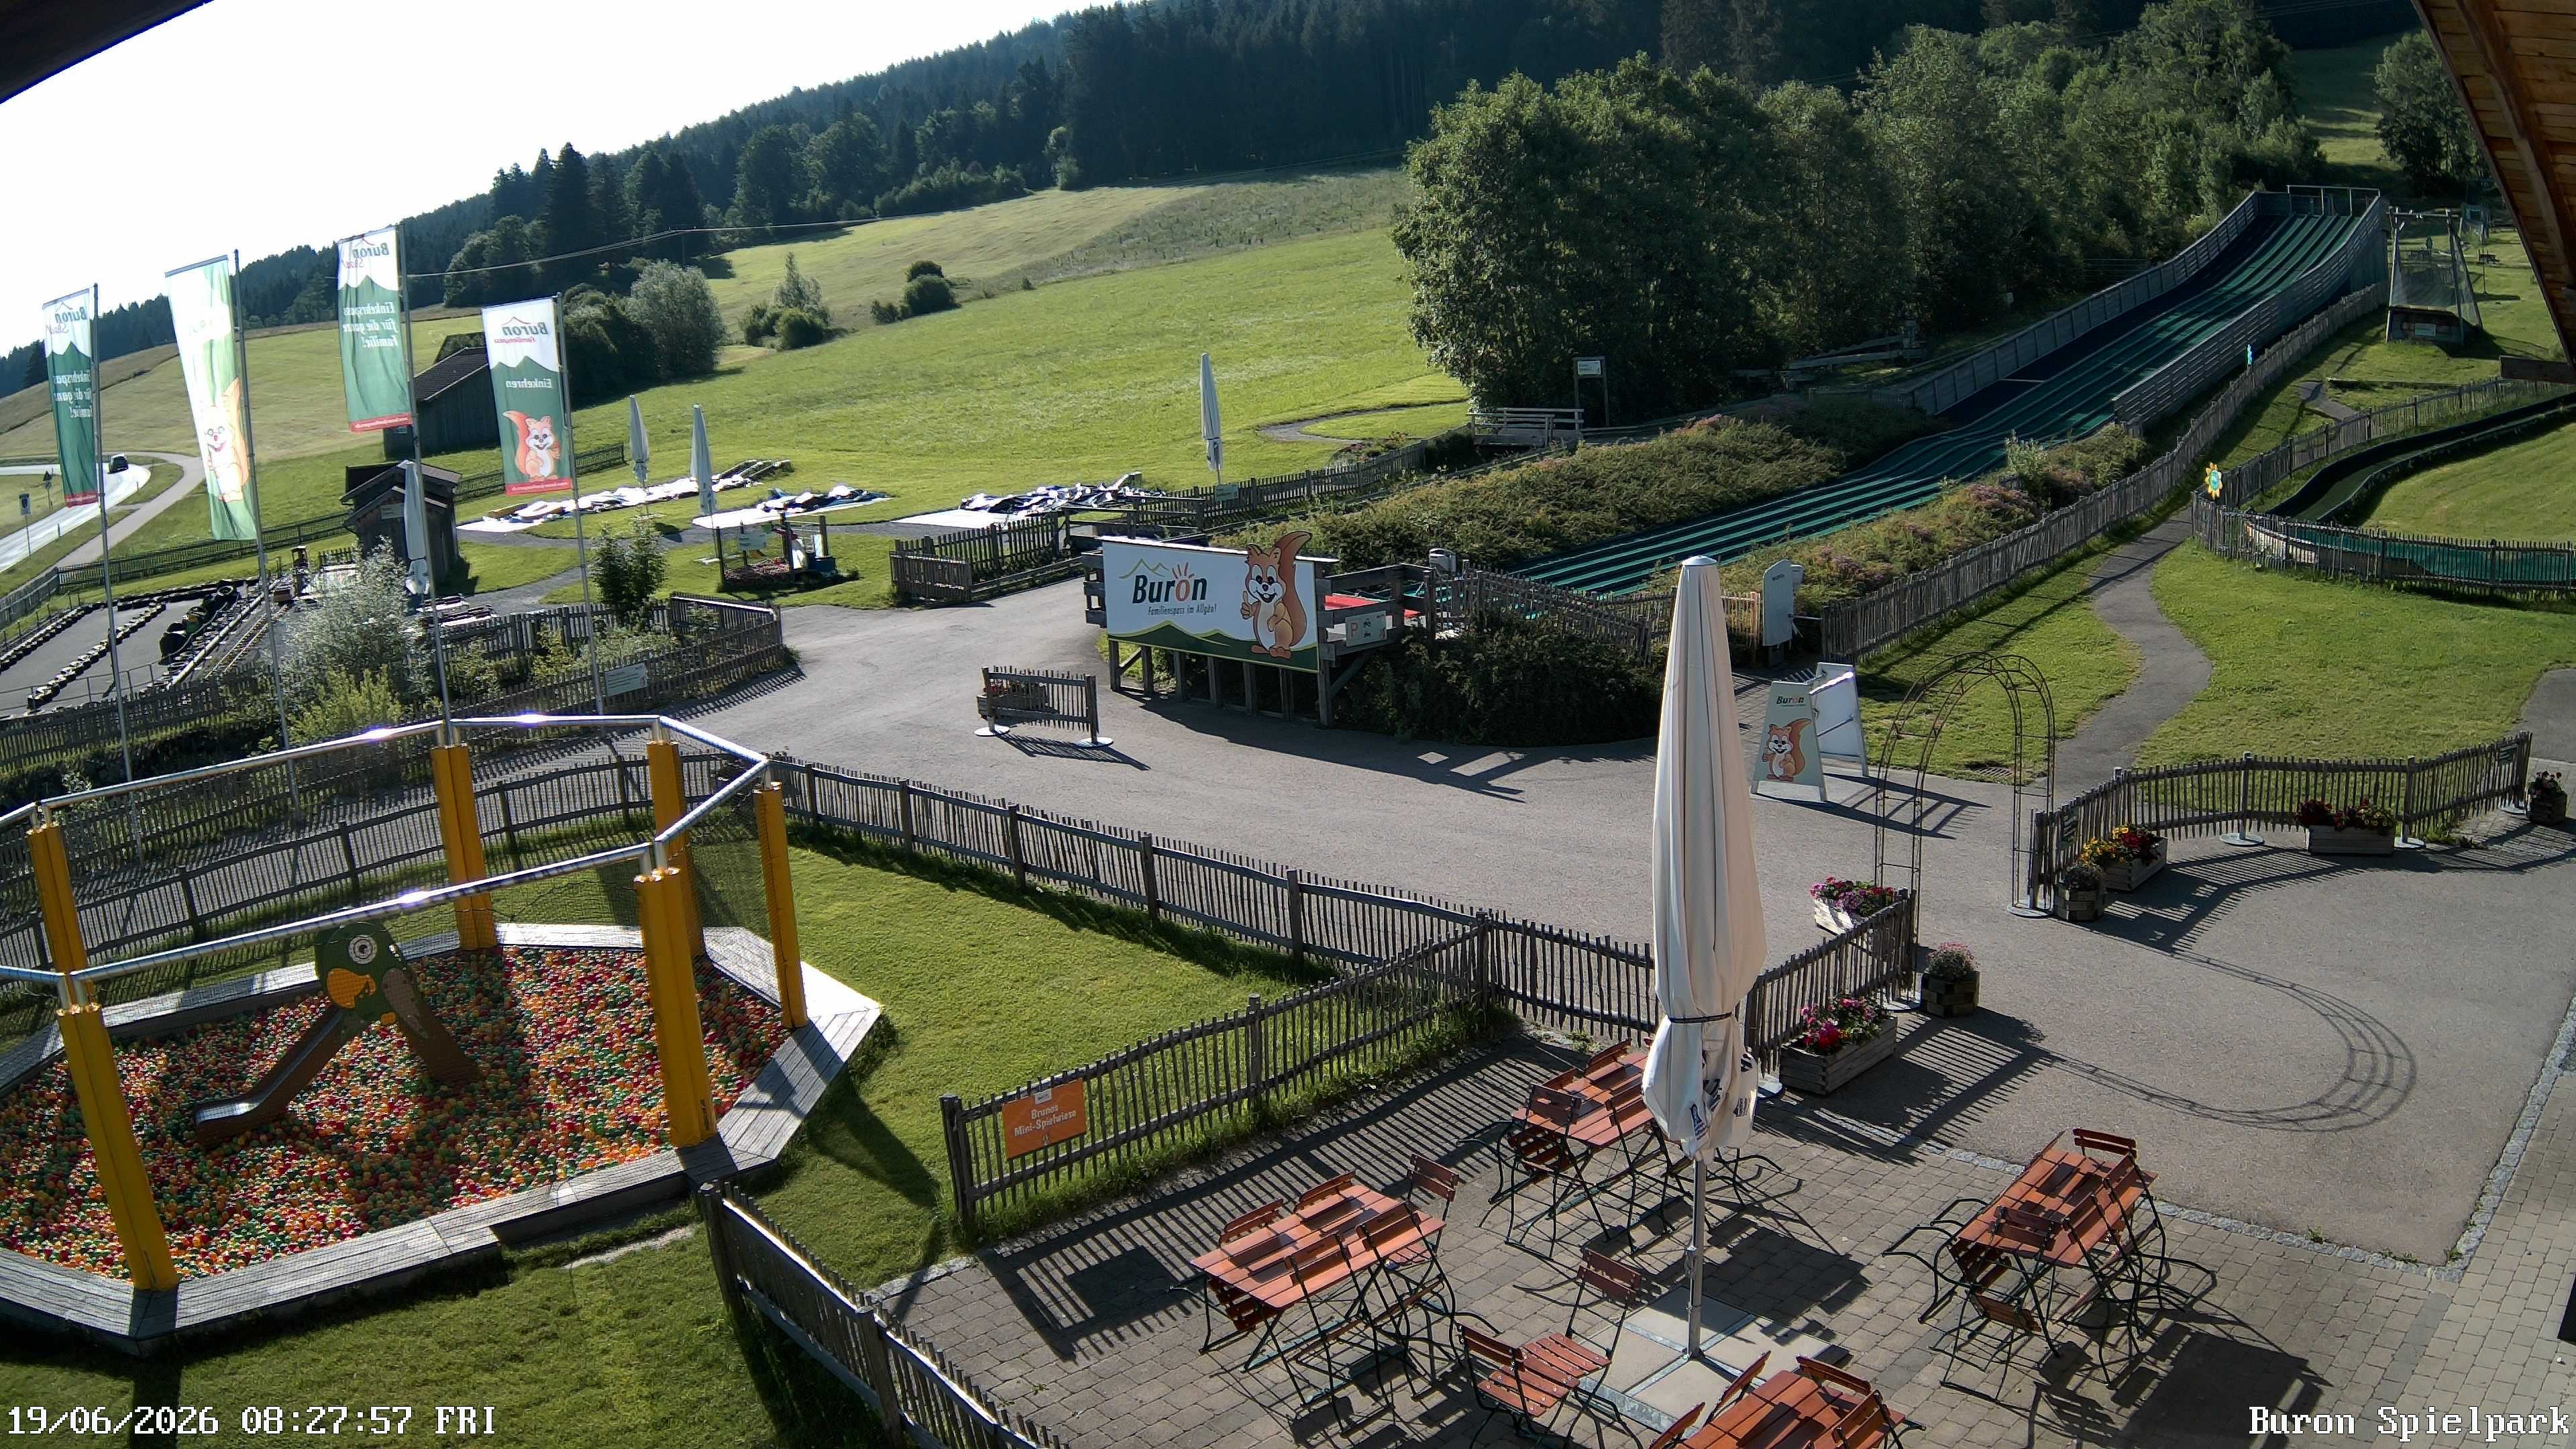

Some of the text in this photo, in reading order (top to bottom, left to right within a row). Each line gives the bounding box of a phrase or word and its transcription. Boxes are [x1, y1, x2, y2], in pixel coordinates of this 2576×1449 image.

[1132, 574, 1208, 604] Buron
[1350, 622, 1358, 638] P
[1776, 696, 1805, 704] Buron
